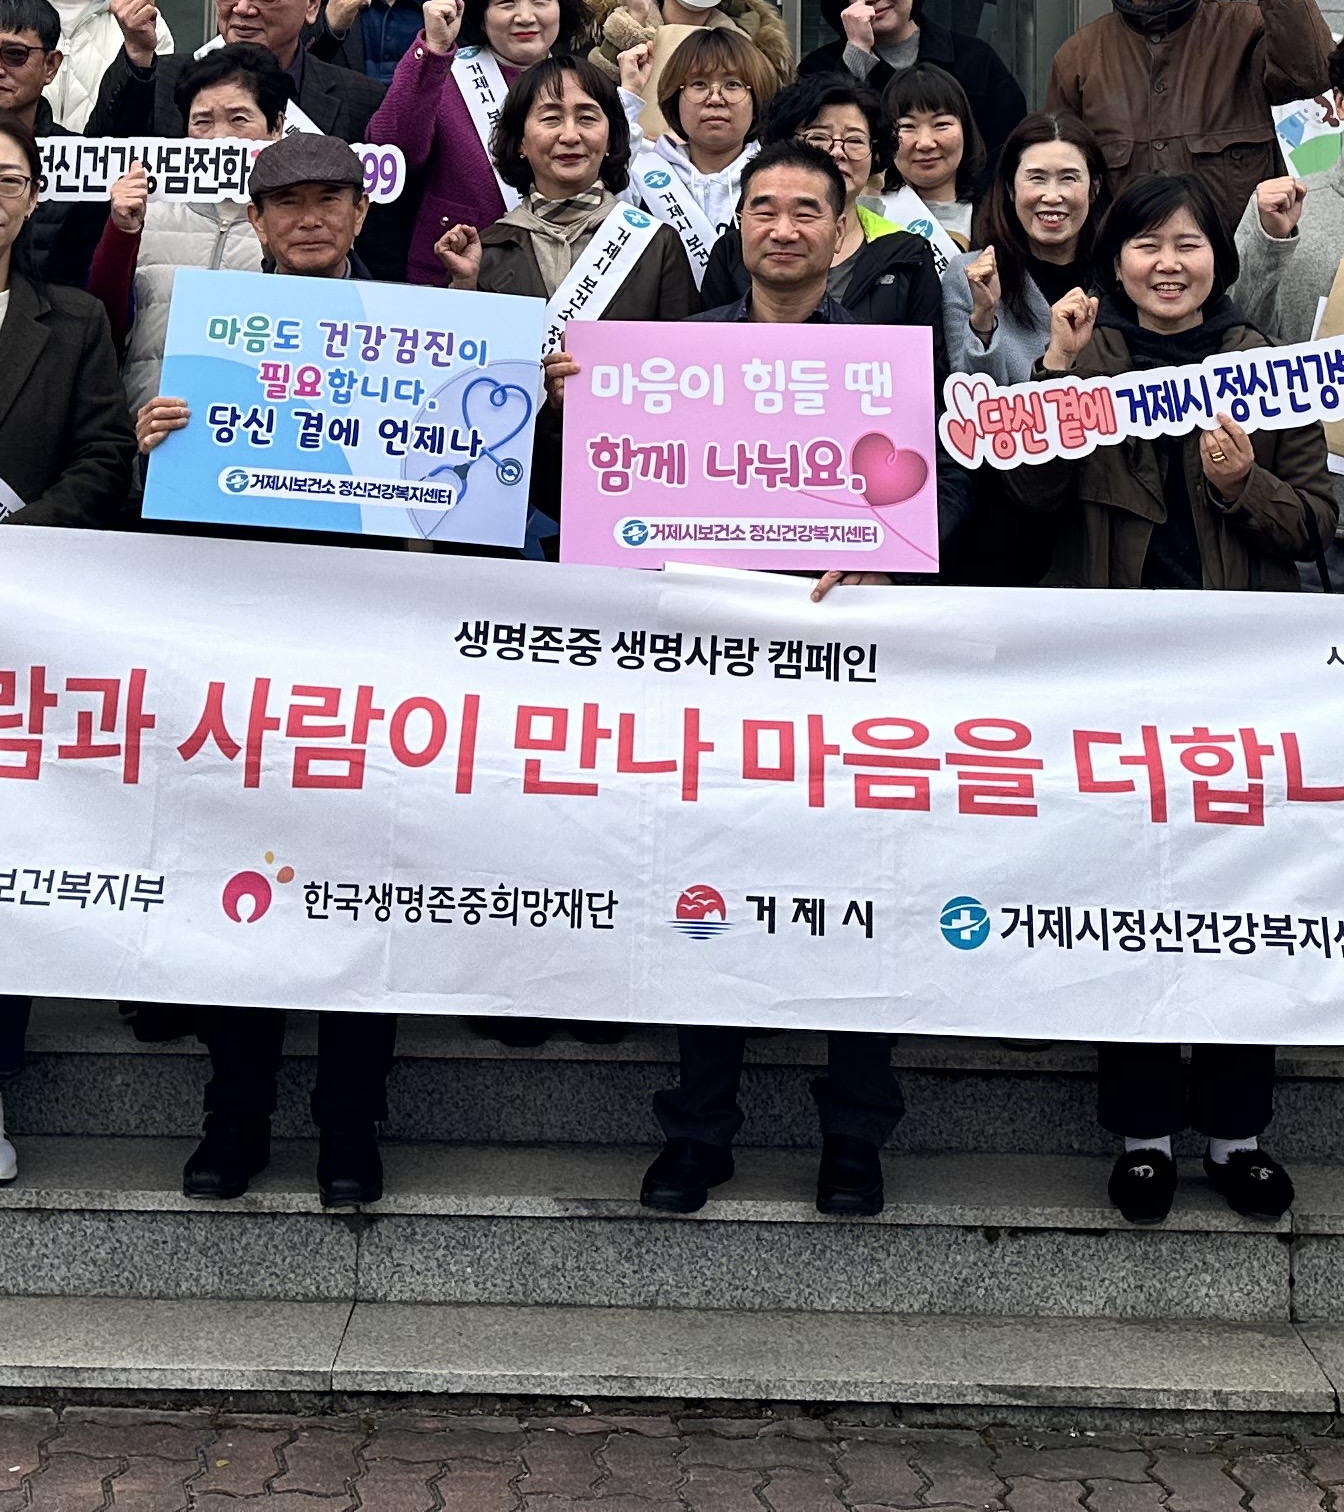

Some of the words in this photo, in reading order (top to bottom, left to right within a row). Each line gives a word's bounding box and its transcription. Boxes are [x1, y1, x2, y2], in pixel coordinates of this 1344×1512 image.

[465, 63, 496, 105] 거제시
[658, 191, 693, 233] 거제시
[592, 226, 632, 276] 거제시
[207, 315, 302, 354] 마음도
[319, 321, 488, 368] 건강검진이
[258, 361, 439, 410] 필요합니다.
[591, 357, 725, 415] 마음이
[741, 357, 830, 416] 힘들
[844, 360, 894, 416] 땐
[209, 404, 277, 446] 당신
[294, 410, 359, 449] 곁에
[378, 418, 484, 459] 언제나
[978, 396, 1047, 459] 당신
[1046, 386, 1118, 448] 곁에
[1117, 374, 1212, 428] 거제시
[250, 472, 336, 495] 거제시보건소
[339, 479, 452, 506] 정신건강복지센터
[590, 435, 687, 494] 함께
[705, 440, 866, 493] 나눠요.
[650, 523, 746, 544] 거제시보건소
[749, 524, 878, 545] 정신건강복지센터
[453, 619, 603, 667] 생명존중
[610, 626, 759, 679] 생명사랑
[766, 637, 879, 684] 캠페인
[177, 677, 482, 795] 사람이
[513, 701, 714, 804] 만나
[743, 712, 1044, 819] 마음을
[303, 879, 619, 931] 한국생명존중희망재단
[745, 895, 876, 939] 거제시
